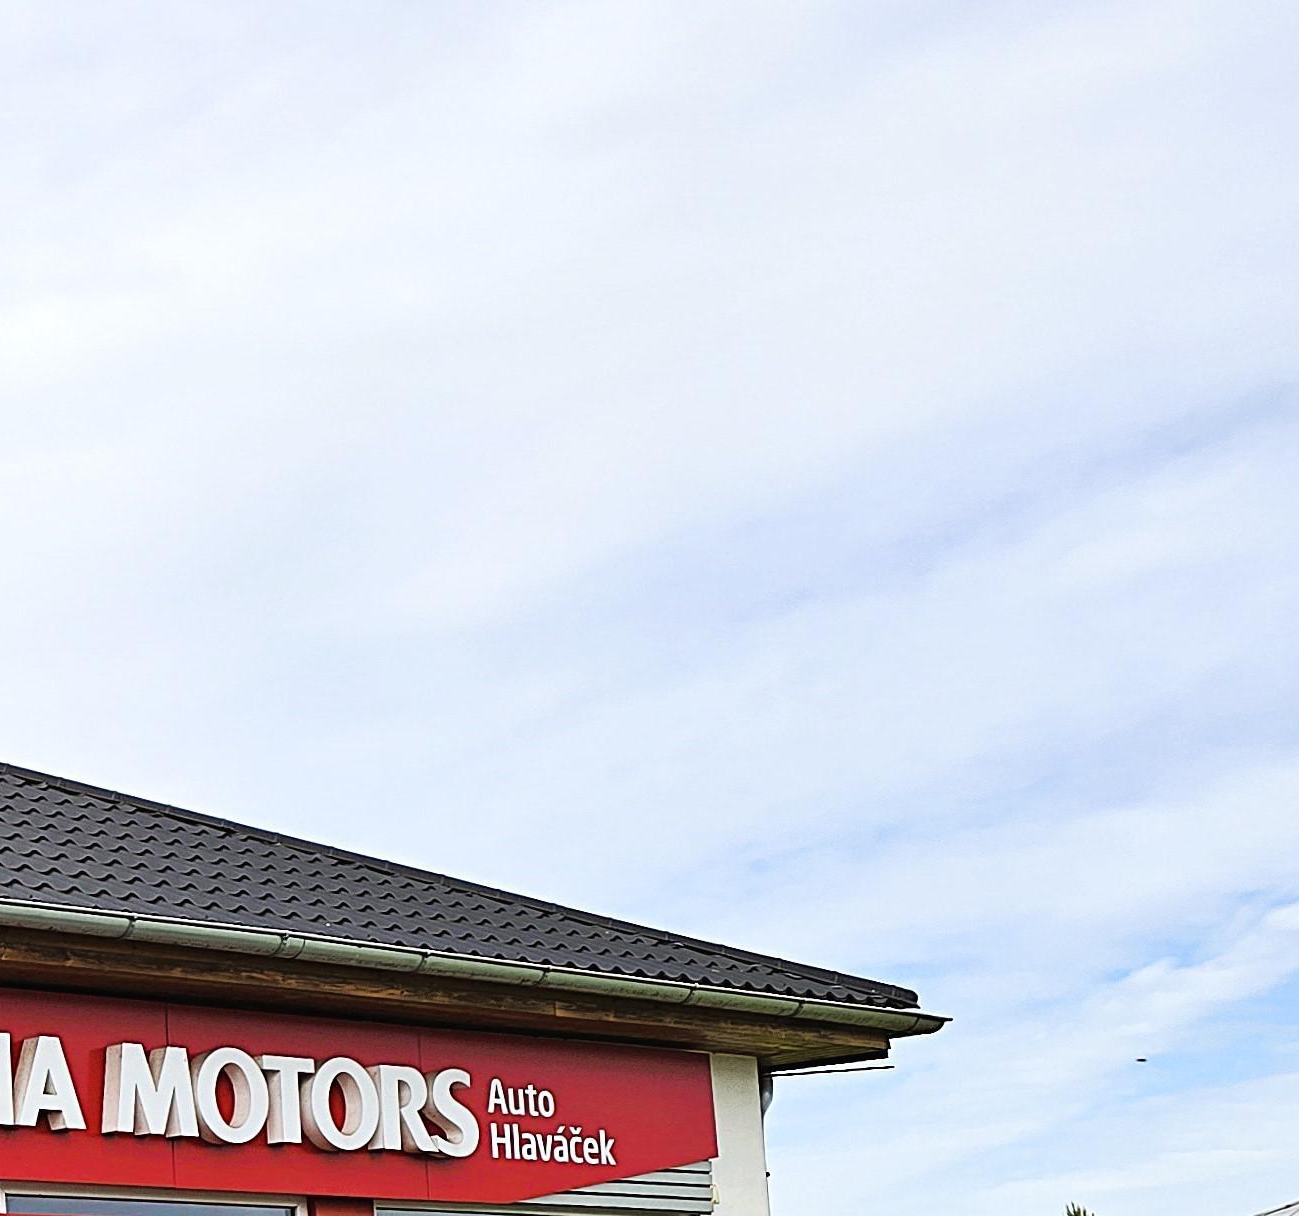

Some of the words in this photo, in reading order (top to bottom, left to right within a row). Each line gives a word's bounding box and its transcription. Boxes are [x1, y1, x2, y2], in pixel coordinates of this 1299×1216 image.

[101, 1042, 480, 1159] MOTORS
[487, 1077, 556, 1118] Auto
[489, 1121, 618, 1166] Hlaváček
